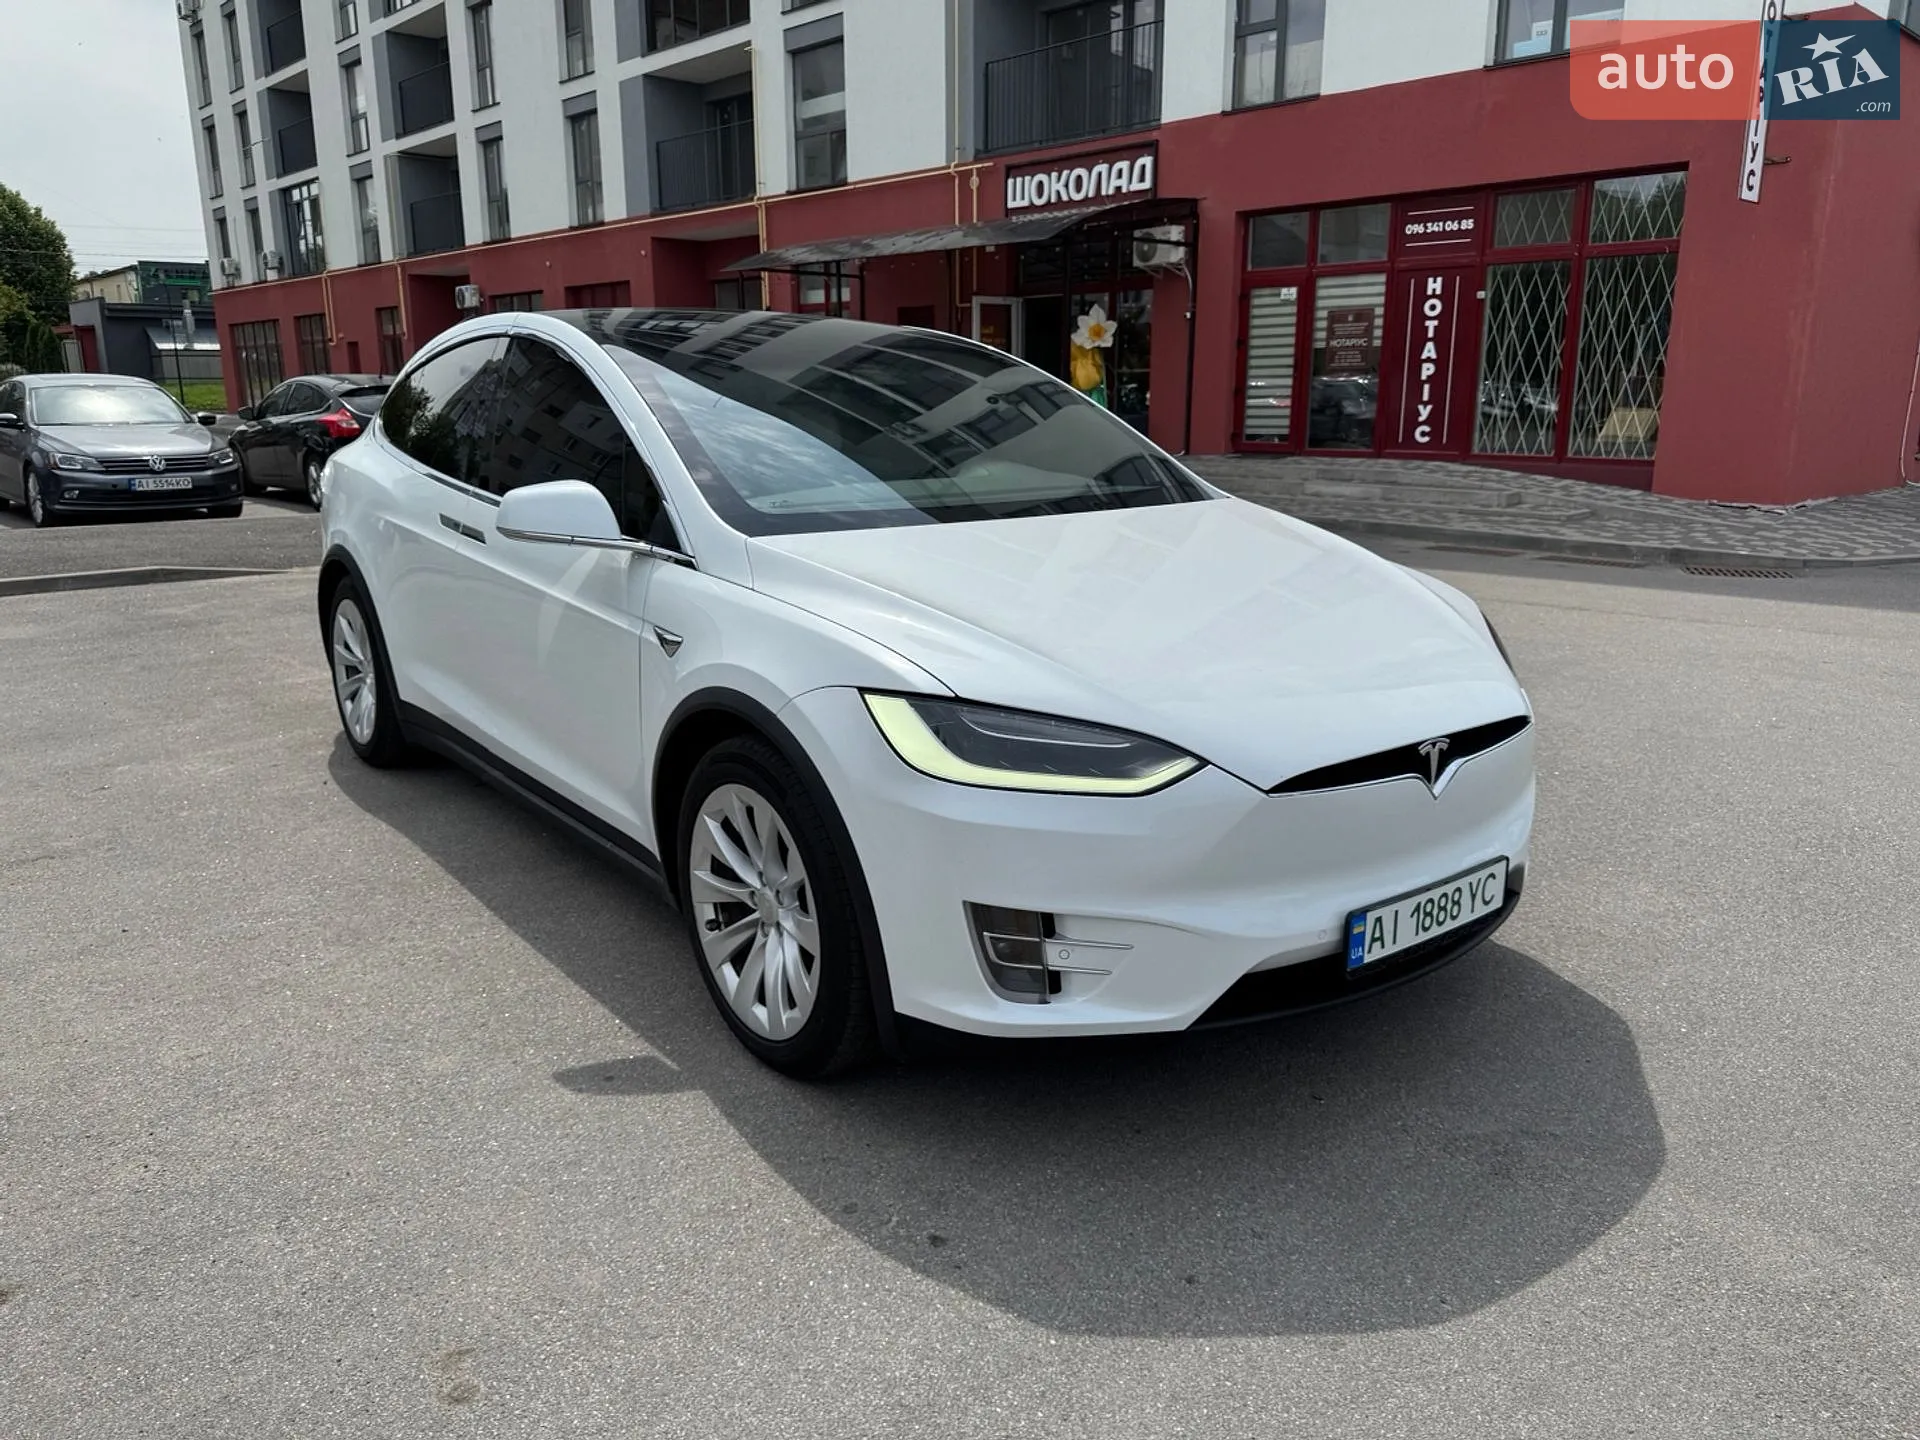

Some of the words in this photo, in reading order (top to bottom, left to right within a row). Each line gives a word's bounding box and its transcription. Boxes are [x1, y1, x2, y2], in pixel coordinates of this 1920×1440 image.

[1007, 155, 1155, 210] ШОКОЛАД
[1405, 223, 1425, 235] 096
[1426, 221, 1444, 233] 341
[1445, 220, 1460, 232] 06
[1460, 218, 1475, 230] 85
[1414, 276, 1443, 444] НОТАРІУС
[1367, 910, 1399, 955] AI
[1410, 886, 1463, 937] 1888
[1468, 872, 1497, 914] YC
[1350, 946, 1364, 960] UA
